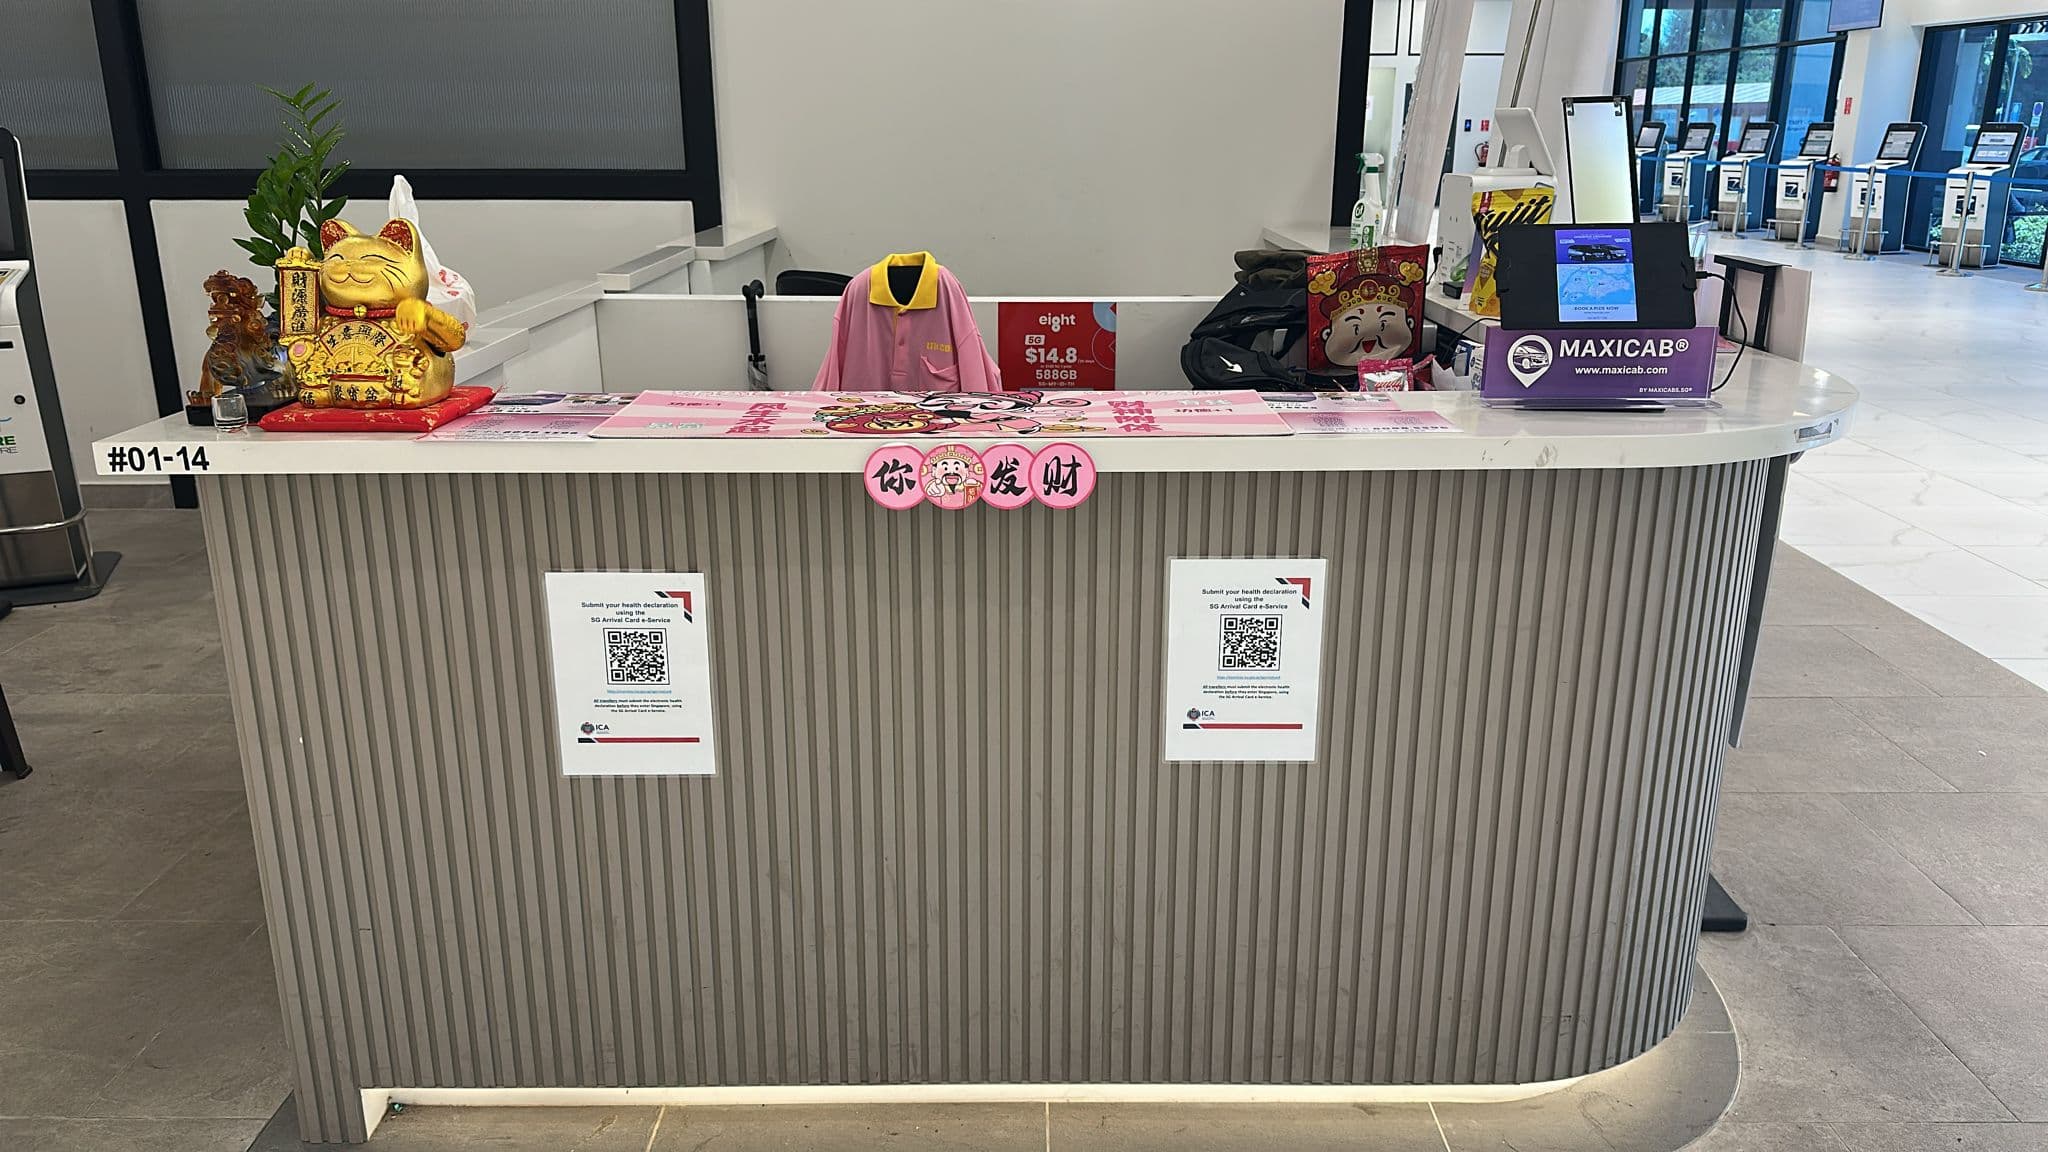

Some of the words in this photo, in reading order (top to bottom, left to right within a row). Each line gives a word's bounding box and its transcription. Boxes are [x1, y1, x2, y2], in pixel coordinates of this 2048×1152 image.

[1038, 312, 1076, 332] eight
[1028, 336, 1042, 344] 5G
[1025, 346, 1078, 365] $14.8
[1035, 369, 1078, 380] 588GB
[1575, 365, 1668, 375] www.maxicab.com
[725, 402, 787, 434] 风生水起
[108, 446, 209, 472] #01-14
[872, 458, 916, 496] 你
